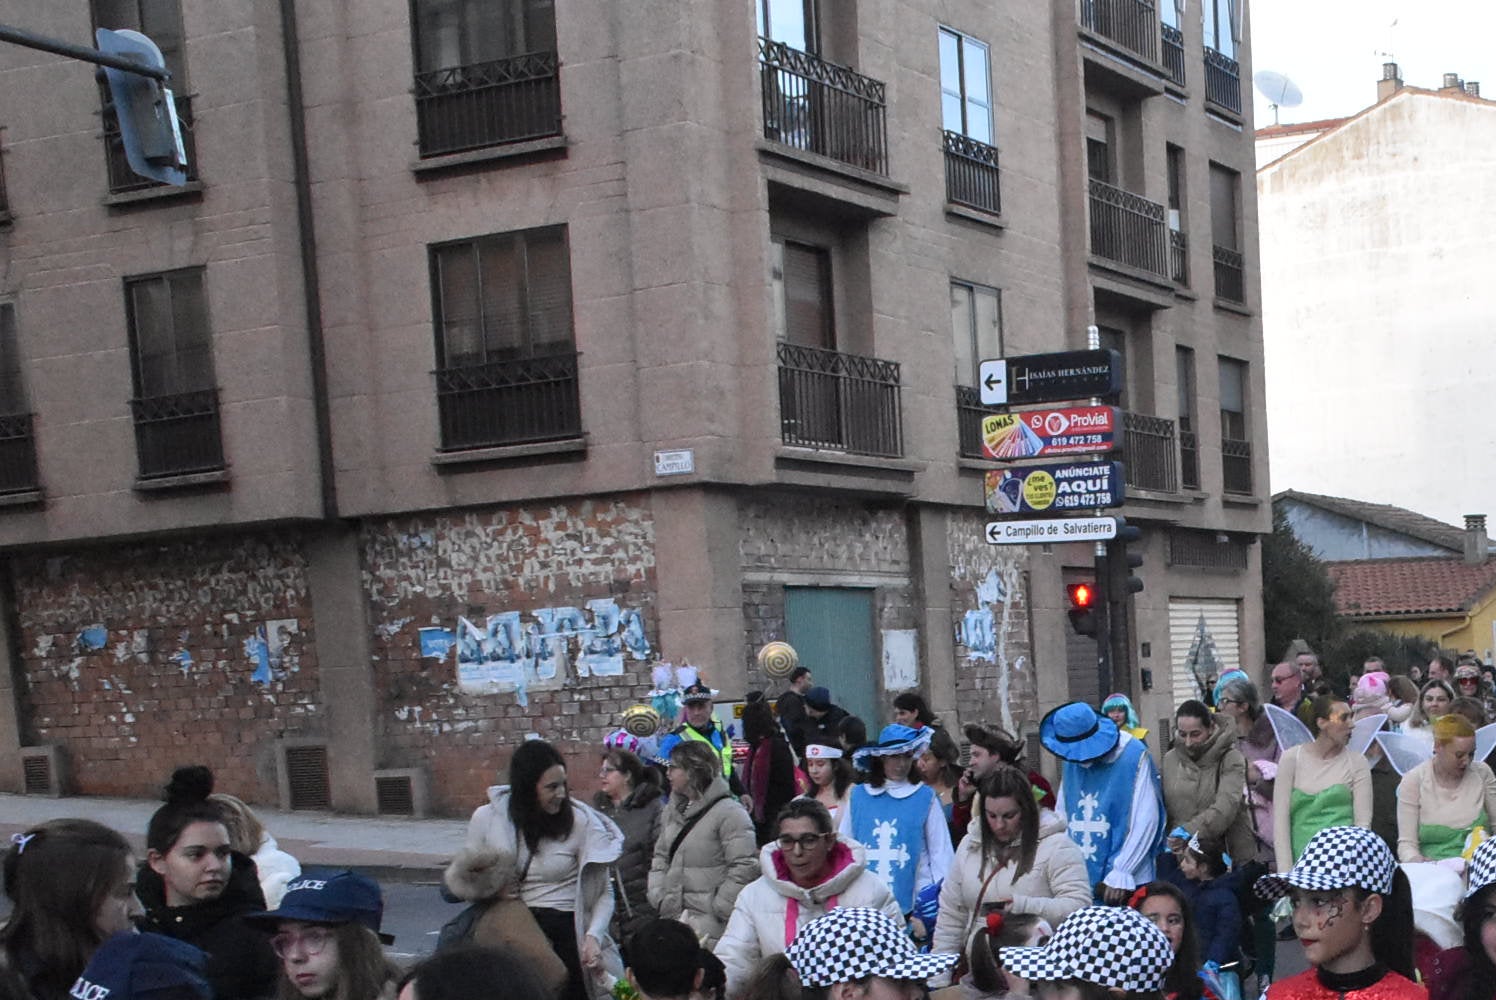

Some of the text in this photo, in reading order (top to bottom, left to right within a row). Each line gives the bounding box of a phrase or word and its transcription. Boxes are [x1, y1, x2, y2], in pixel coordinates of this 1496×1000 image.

[1030, 366, 1109, 380] ISAÍAS HERNÁNDEZ
[985, 415, 1015, 435] LOMAS
[1071, 412, 1108, 428] ProVial
[1052, 435, 1102, 447] 619 472 758
[1055, 466, 1110, 479] ANÚNCIATE
[1058, 476, 1109, 494] AQUÍ
[1065, 493, 1112, 507] 619 472 758
[1006, 522, 1112, 539] Campillo de Salvatierra
